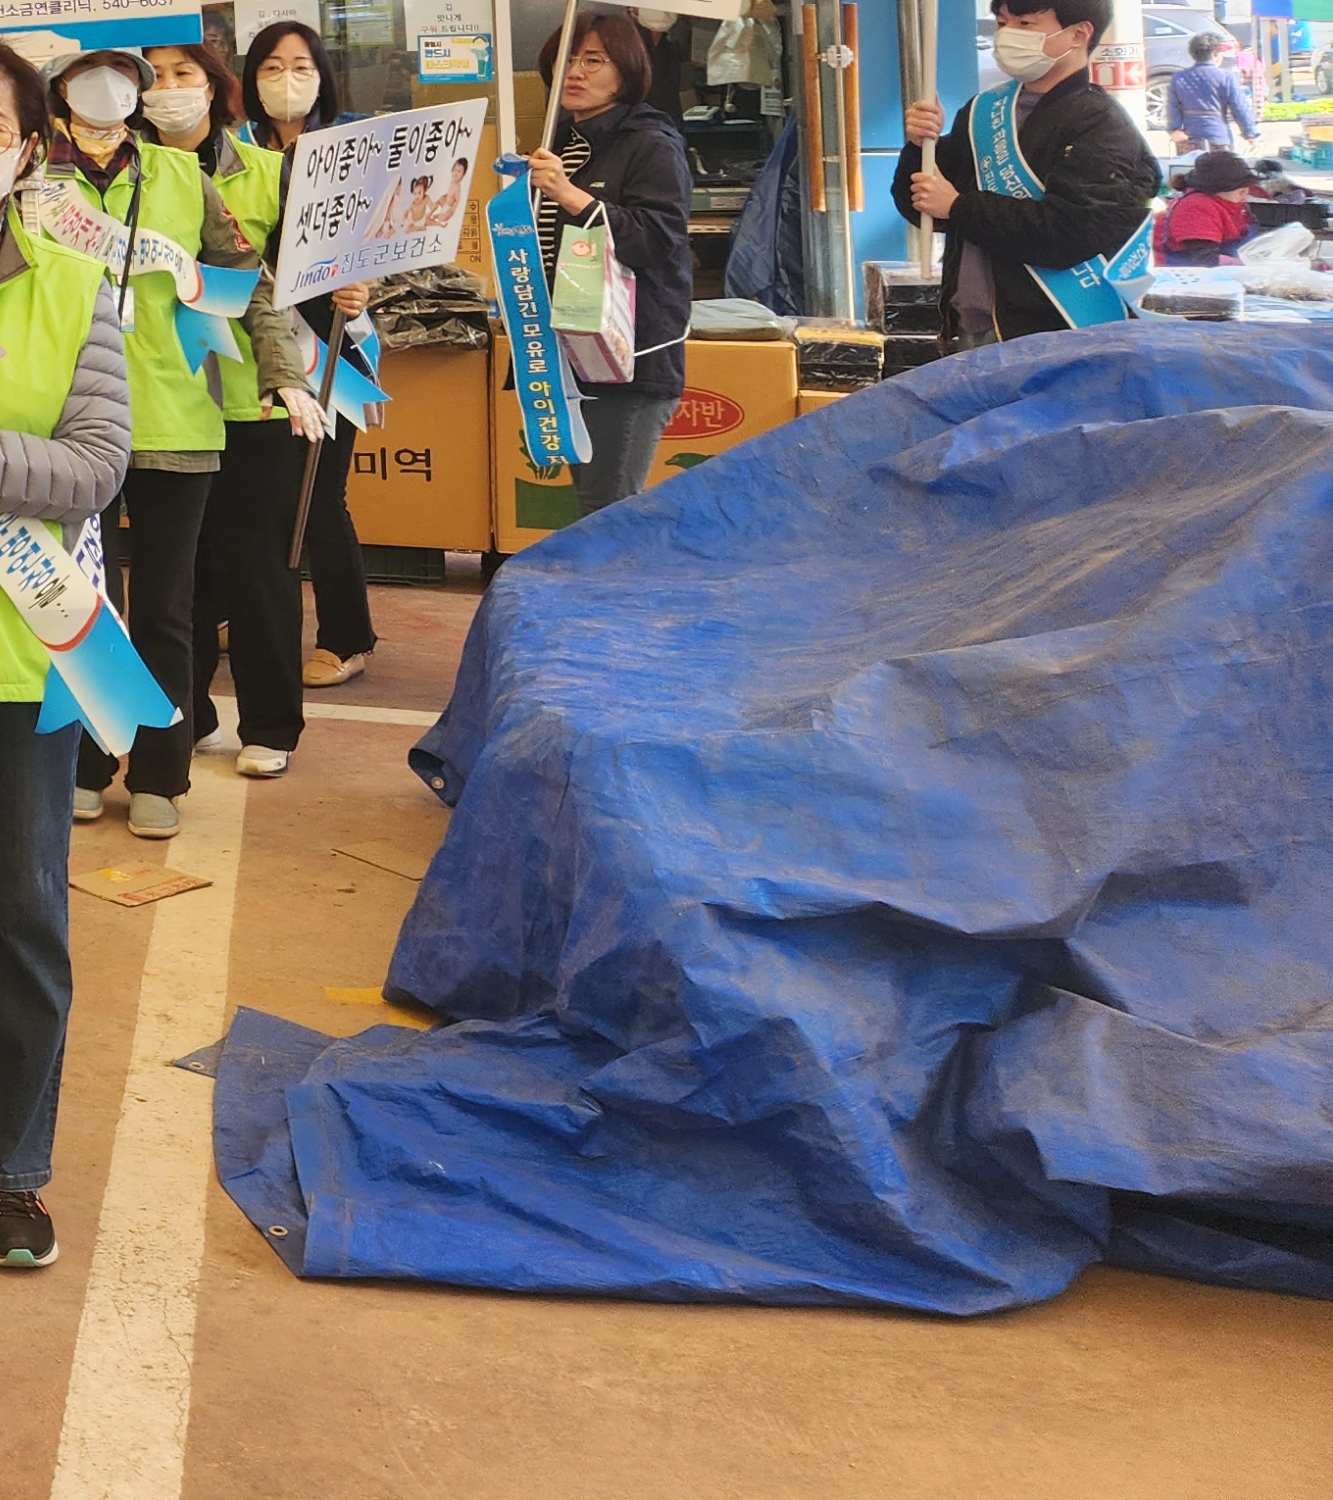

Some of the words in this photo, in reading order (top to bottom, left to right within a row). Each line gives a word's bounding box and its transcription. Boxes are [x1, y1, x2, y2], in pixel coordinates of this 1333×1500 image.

[307, 132, 383, 188] 아이좋아~
[387, 116, 473, 170] 둘이좋아~
[296, 188, 372, 247] 셋더좋아~
[291, 264, 330, 293] Jindo
[341, 232, 443, 275] 진도군보건소
[667, 400, 725, 428] 자반
[353, 448, 432, 483] 미역
